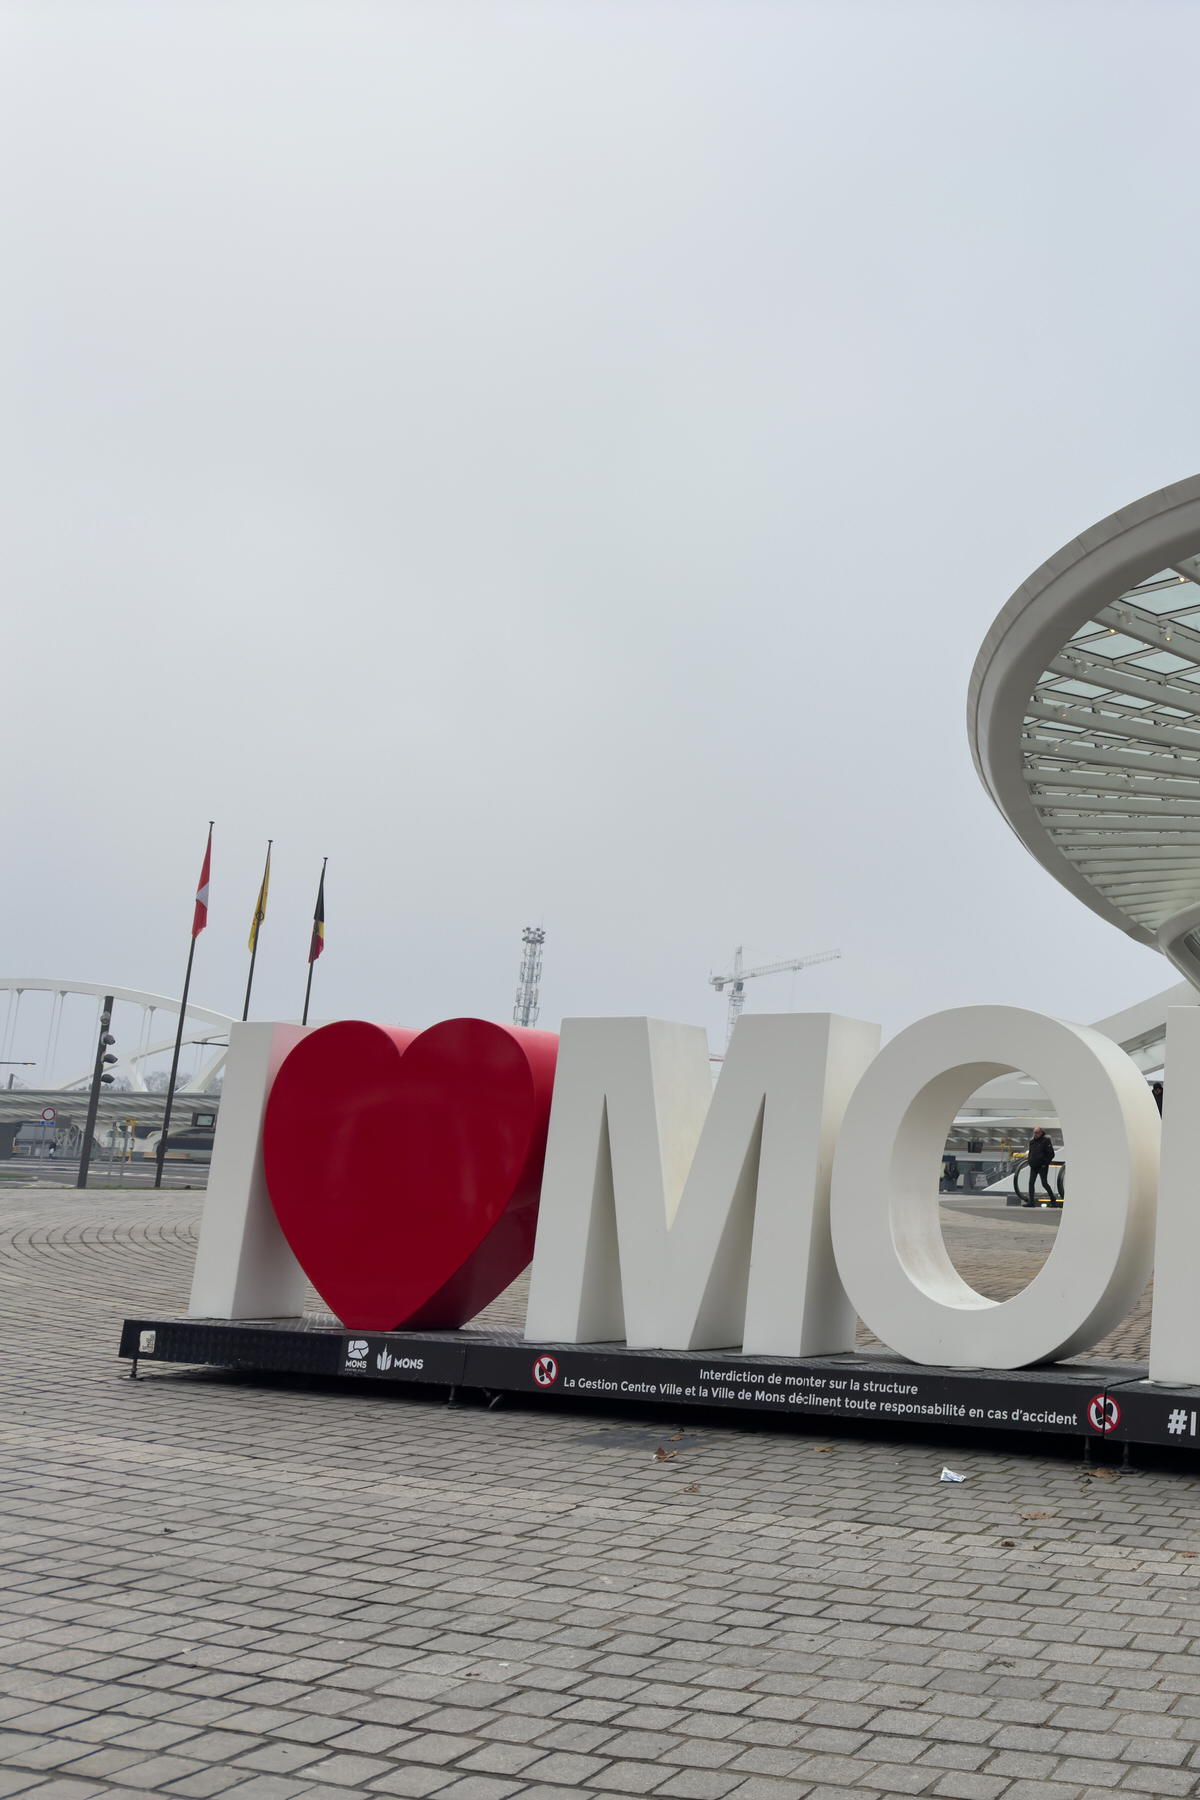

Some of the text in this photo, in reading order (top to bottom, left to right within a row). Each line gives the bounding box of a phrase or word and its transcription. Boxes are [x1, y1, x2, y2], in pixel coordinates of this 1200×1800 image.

[188, 1021, 298, 1320] I
[345, 1360, 367, 1369] MONS
[393, 1358, 424, 1370] MONS
[699, 1368, 919, 1395] Interdiction de monter sur la structure
[563, 1377, 576, 1387] La
[578, 1378, 618, 1391] Gestion
[620, 1381, 657, 1394] Centre
[659, 1384, 682, 1395] Ville
[684, 1387, 697, 1397] et
[698, 1386, 709, 1398] la
[711, 1388, 735, 1399] Ville
[737, 1389, 752, 1400] de
[754, 1391, 786, 1403] Mons
[788, 1393, 842, 1408] déclinent
[844, 1398, 877, 1411] toute
[879, 1402, 967, 1417] responsabilité
[968, 1408, 985, 1419] en
[987, 1409, 1009, 1420] cas
